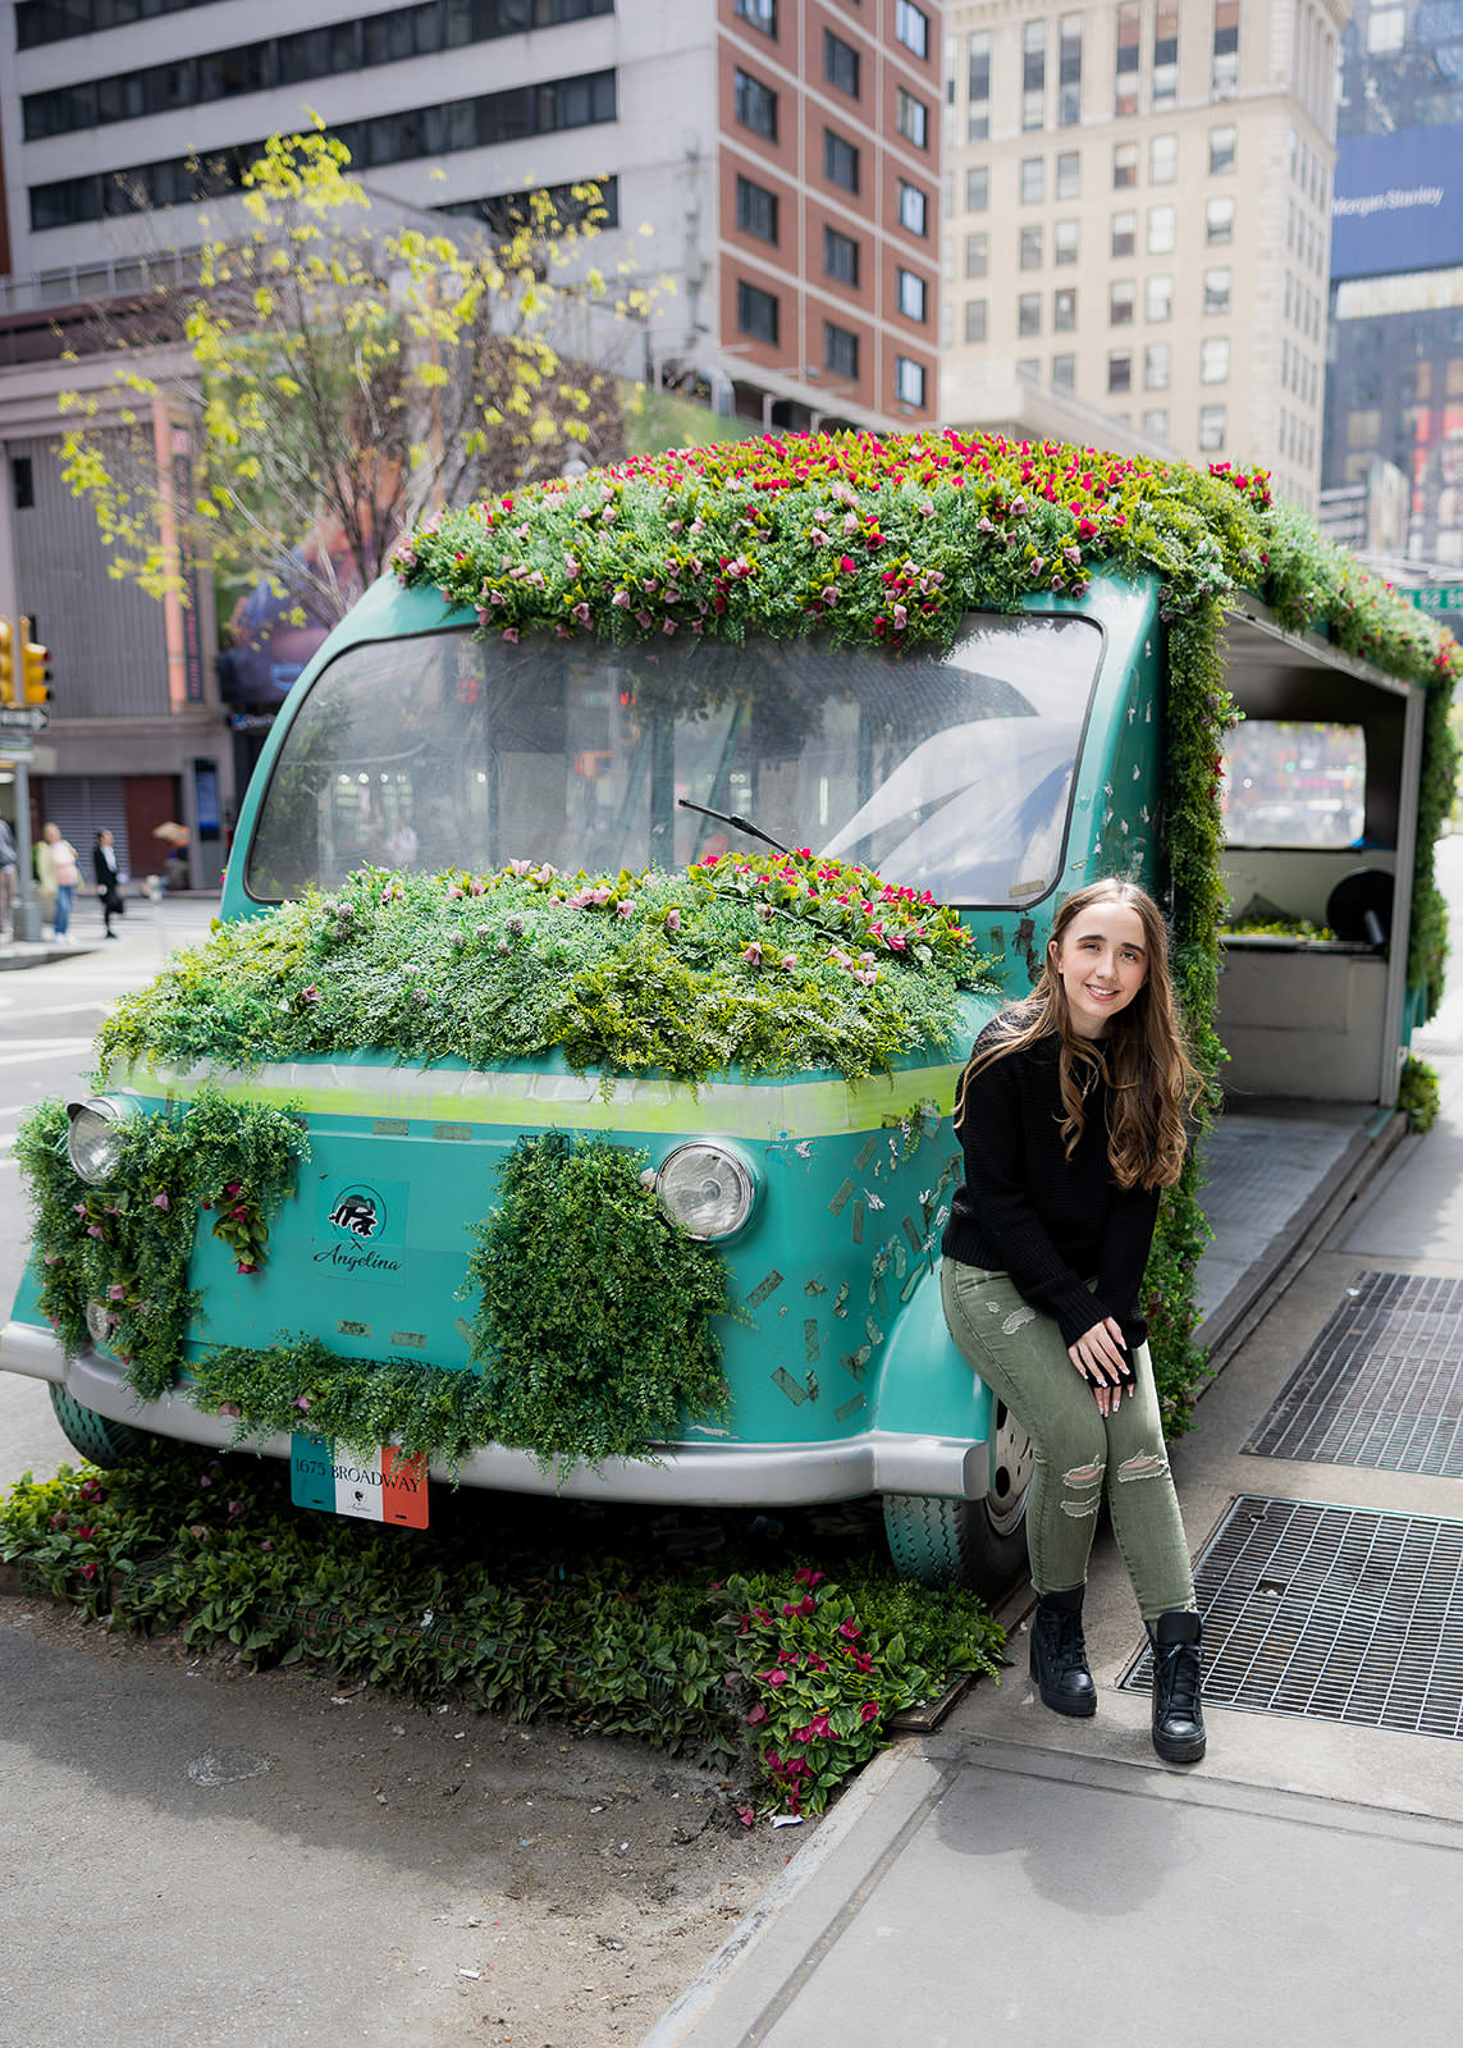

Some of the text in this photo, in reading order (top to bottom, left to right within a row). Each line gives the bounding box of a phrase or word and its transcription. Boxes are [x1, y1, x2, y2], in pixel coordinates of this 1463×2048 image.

[1386, 186, 1444, 210] Stanley
[313, 1244, 402, 1272] Angelina
[296, 1458, 418, 1493] 1675 BROADWAY
